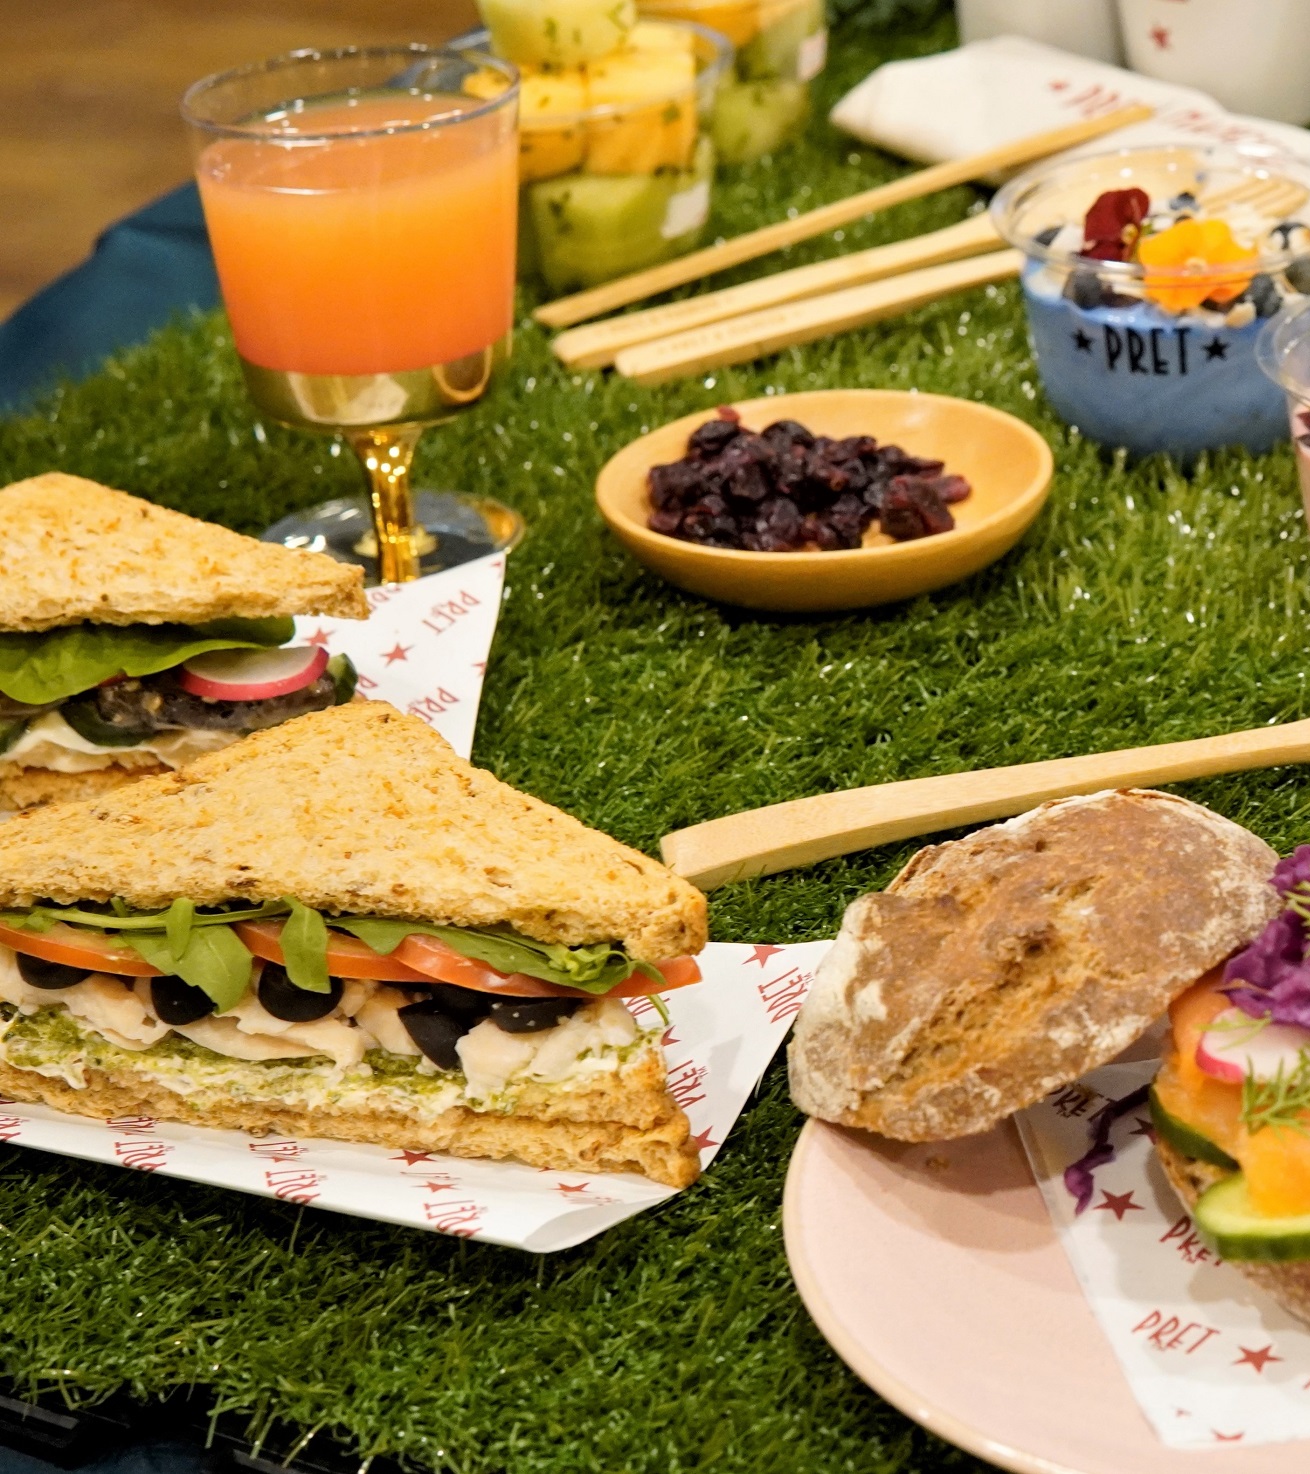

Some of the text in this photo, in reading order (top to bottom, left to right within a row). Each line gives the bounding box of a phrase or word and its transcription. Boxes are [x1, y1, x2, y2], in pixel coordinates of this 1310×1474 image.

[1103, 325, 1192, 376] PRET
[421, 589, 483, 637] PRET
[408, 686, 461, 724] PRE
[1159, 1214, 1223, 1267] PRE
[1131, 1299, 1222, 1355] PRET
